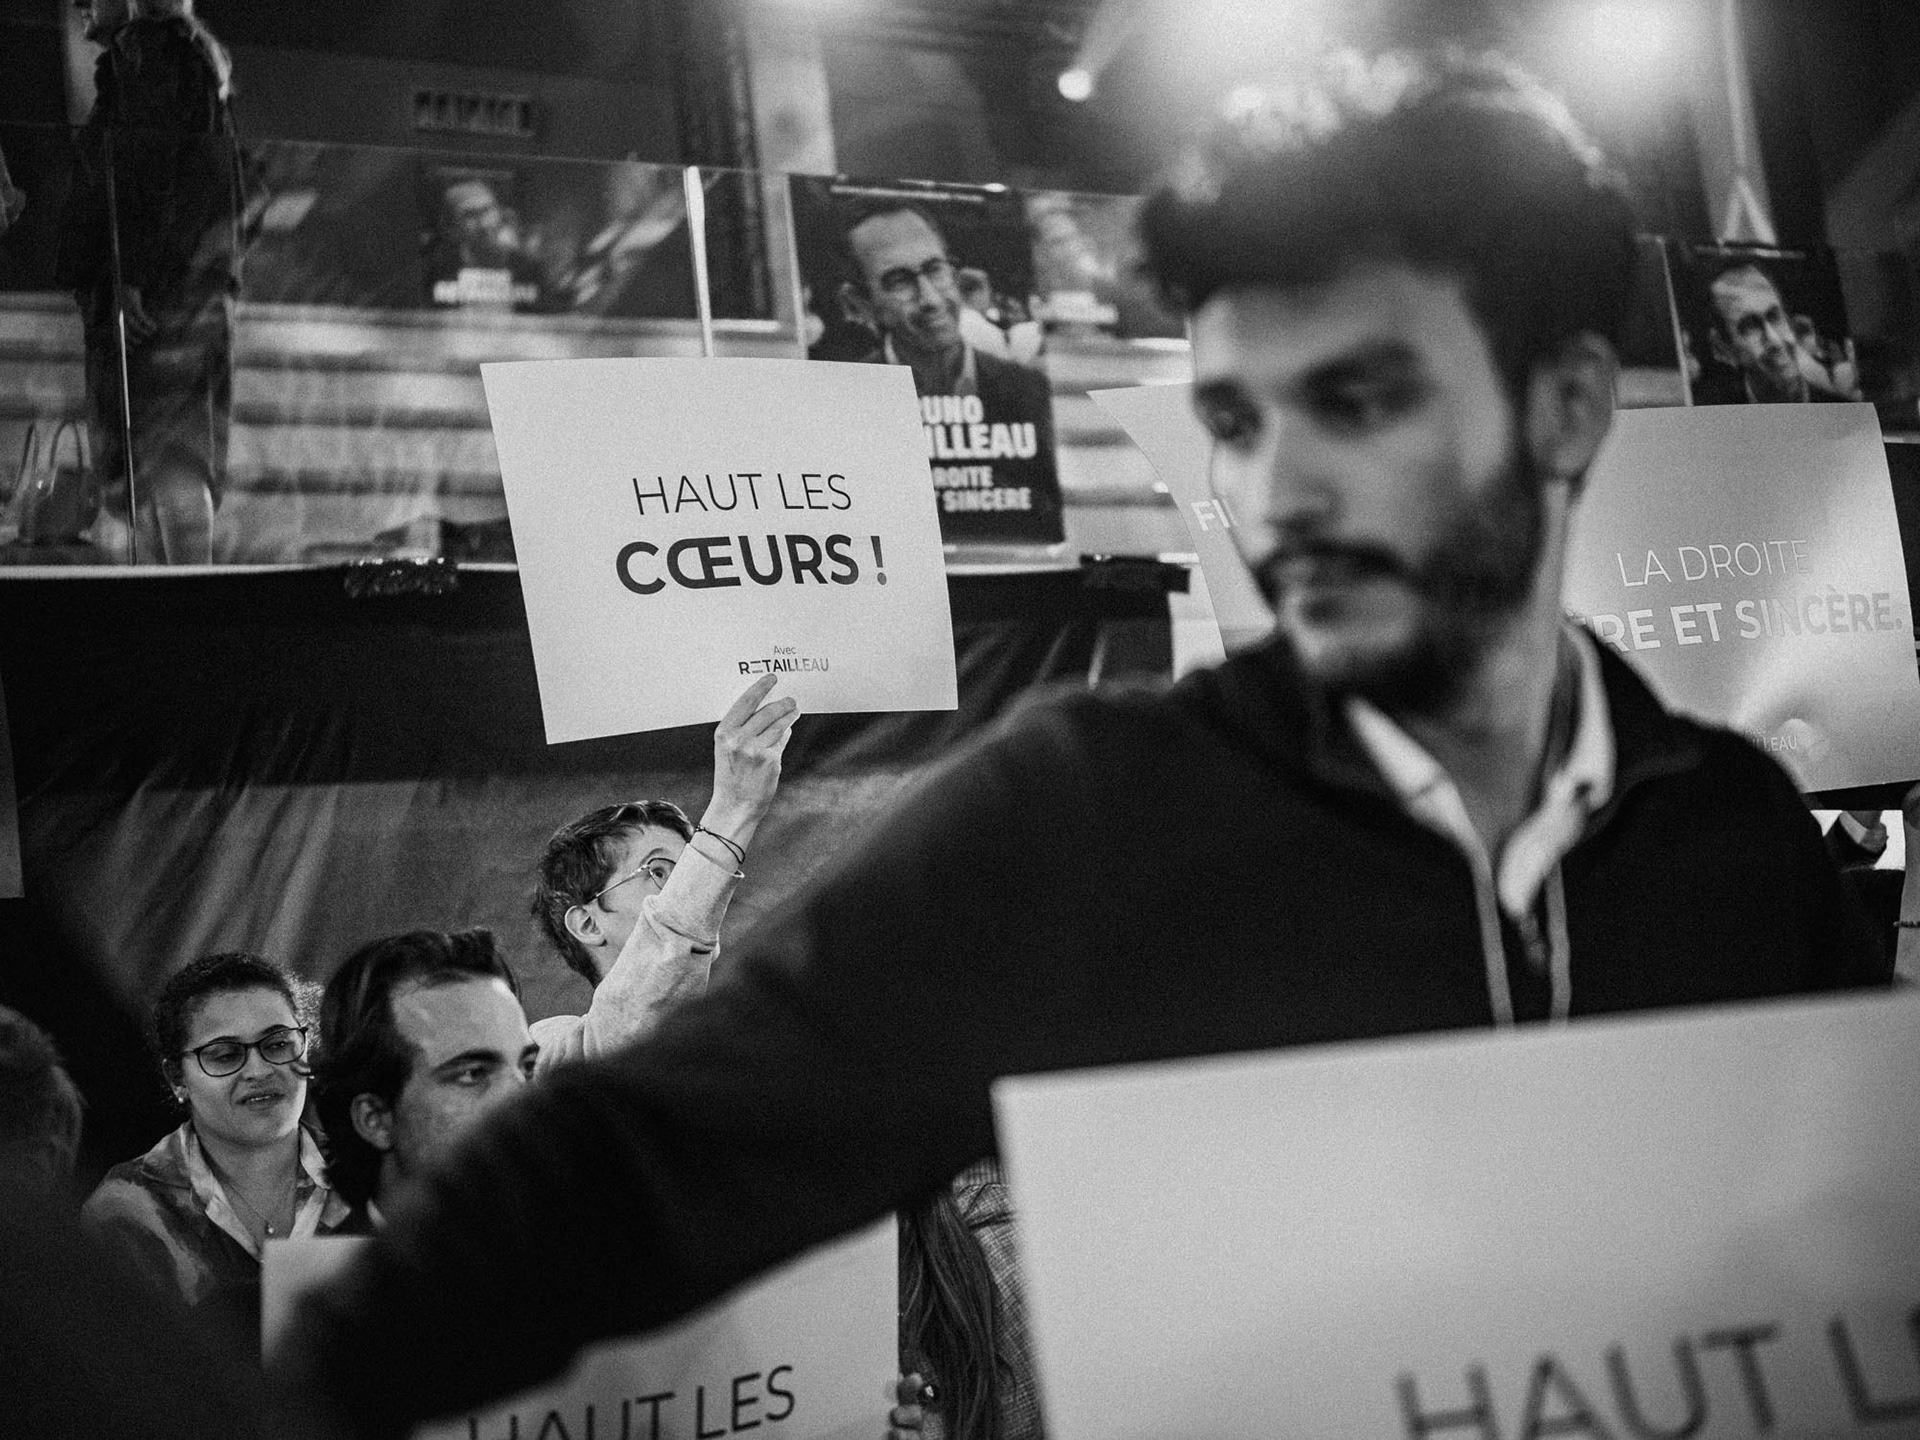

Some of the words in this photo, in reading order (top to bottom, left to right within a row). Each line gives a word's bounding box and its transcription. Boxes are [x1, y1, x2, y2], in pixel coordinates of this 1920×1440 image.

[919, 394, 984, 424] UNO
[924, 422, 1037, 459] ILLEAU
[632, 473, 762, 515] HAUT
[777, 473, 852, 510] LES
[931, 465, 994, 488] ROITE
[615, 533, 860, 595] CŒURS
[1617, 549, 1673, 587] LA
[1678, 539, 1814, 581] DROITE
[1583, 609, 1661, 652] RE
[1670, 602, 1723, 646] ET
[738, 658, 829, 675] RETAILLEAU
[773, 645, 797, 655] Avec
[1396, 1322, 1782, 1440] HAUT
[1825, 1304, 1920, 1426] L
[697, 1365, 795, 1440] LES
